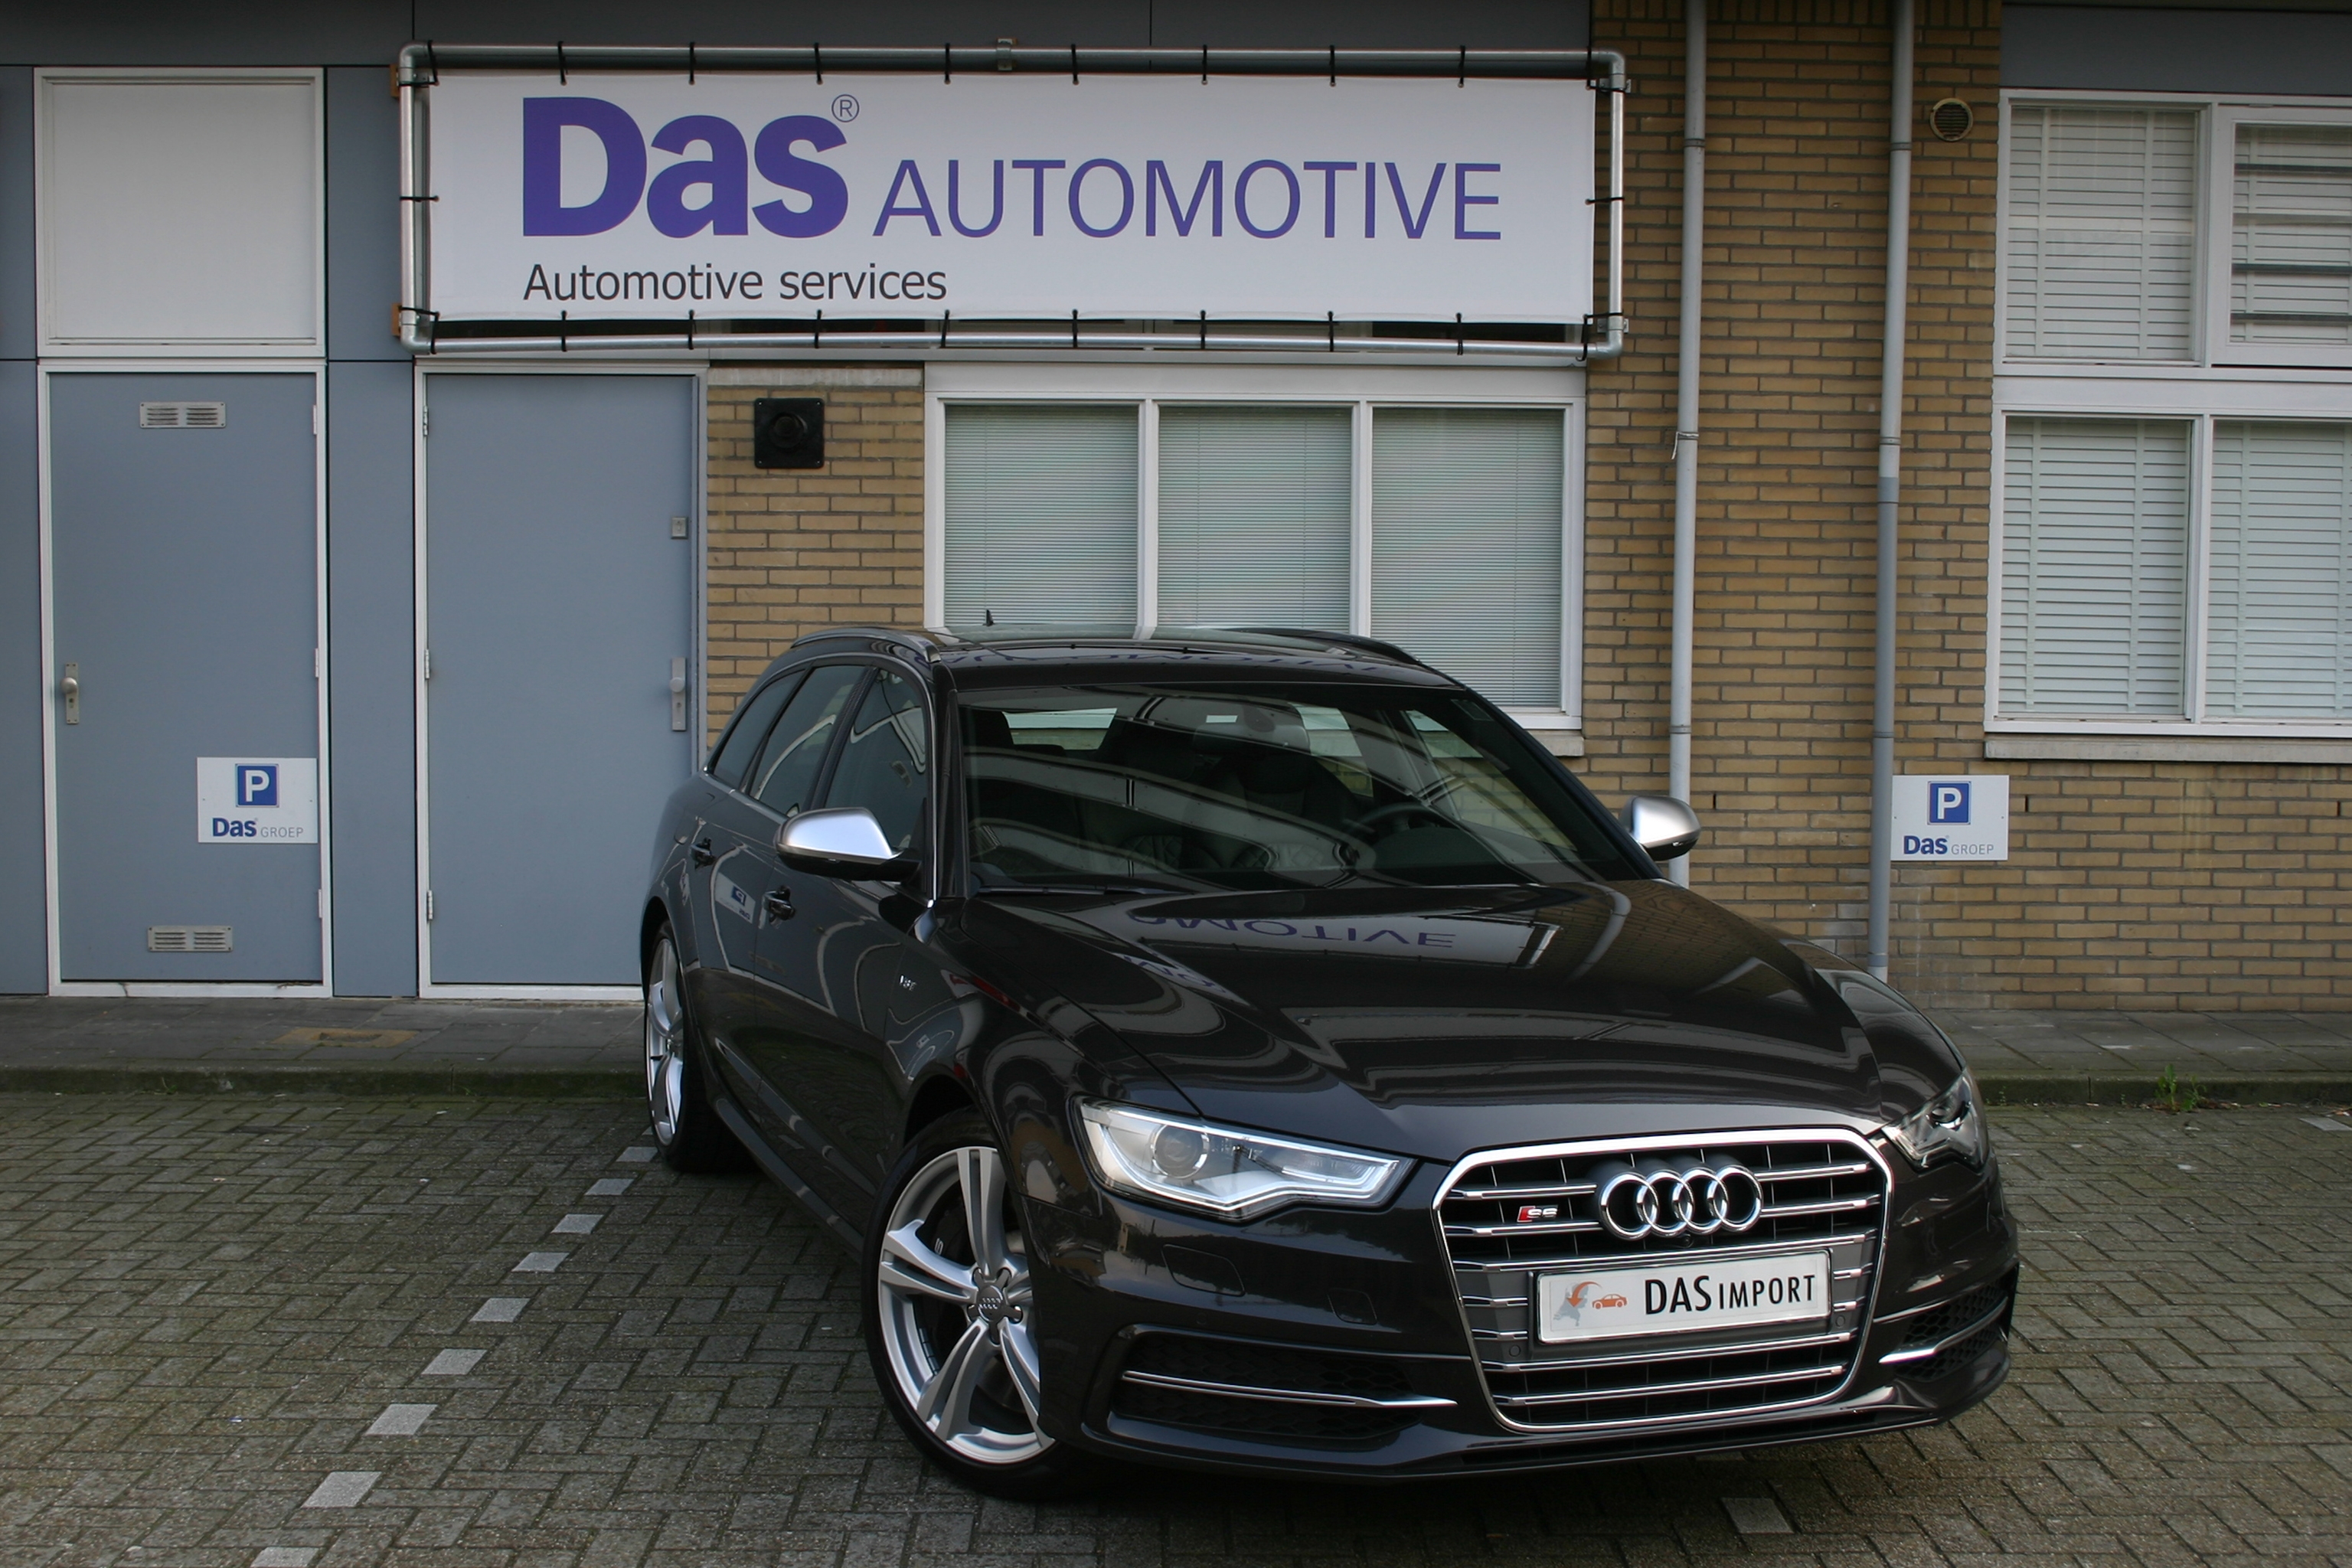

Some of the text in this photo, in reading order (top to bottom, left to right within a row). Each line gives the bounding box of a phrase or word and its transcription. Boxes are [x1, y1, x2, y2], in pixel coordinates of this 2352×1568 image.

[873, 158, 1501, 240] AUTOMOTIVE
[523, 263, 947, 301] Automotive services
[245, 769, 270, 802] P
[1937, 787, 1962, 820] P
[212, 817, 305, 838] Das GROEP
[1903, 835, 1994, 855] Das GROEP
